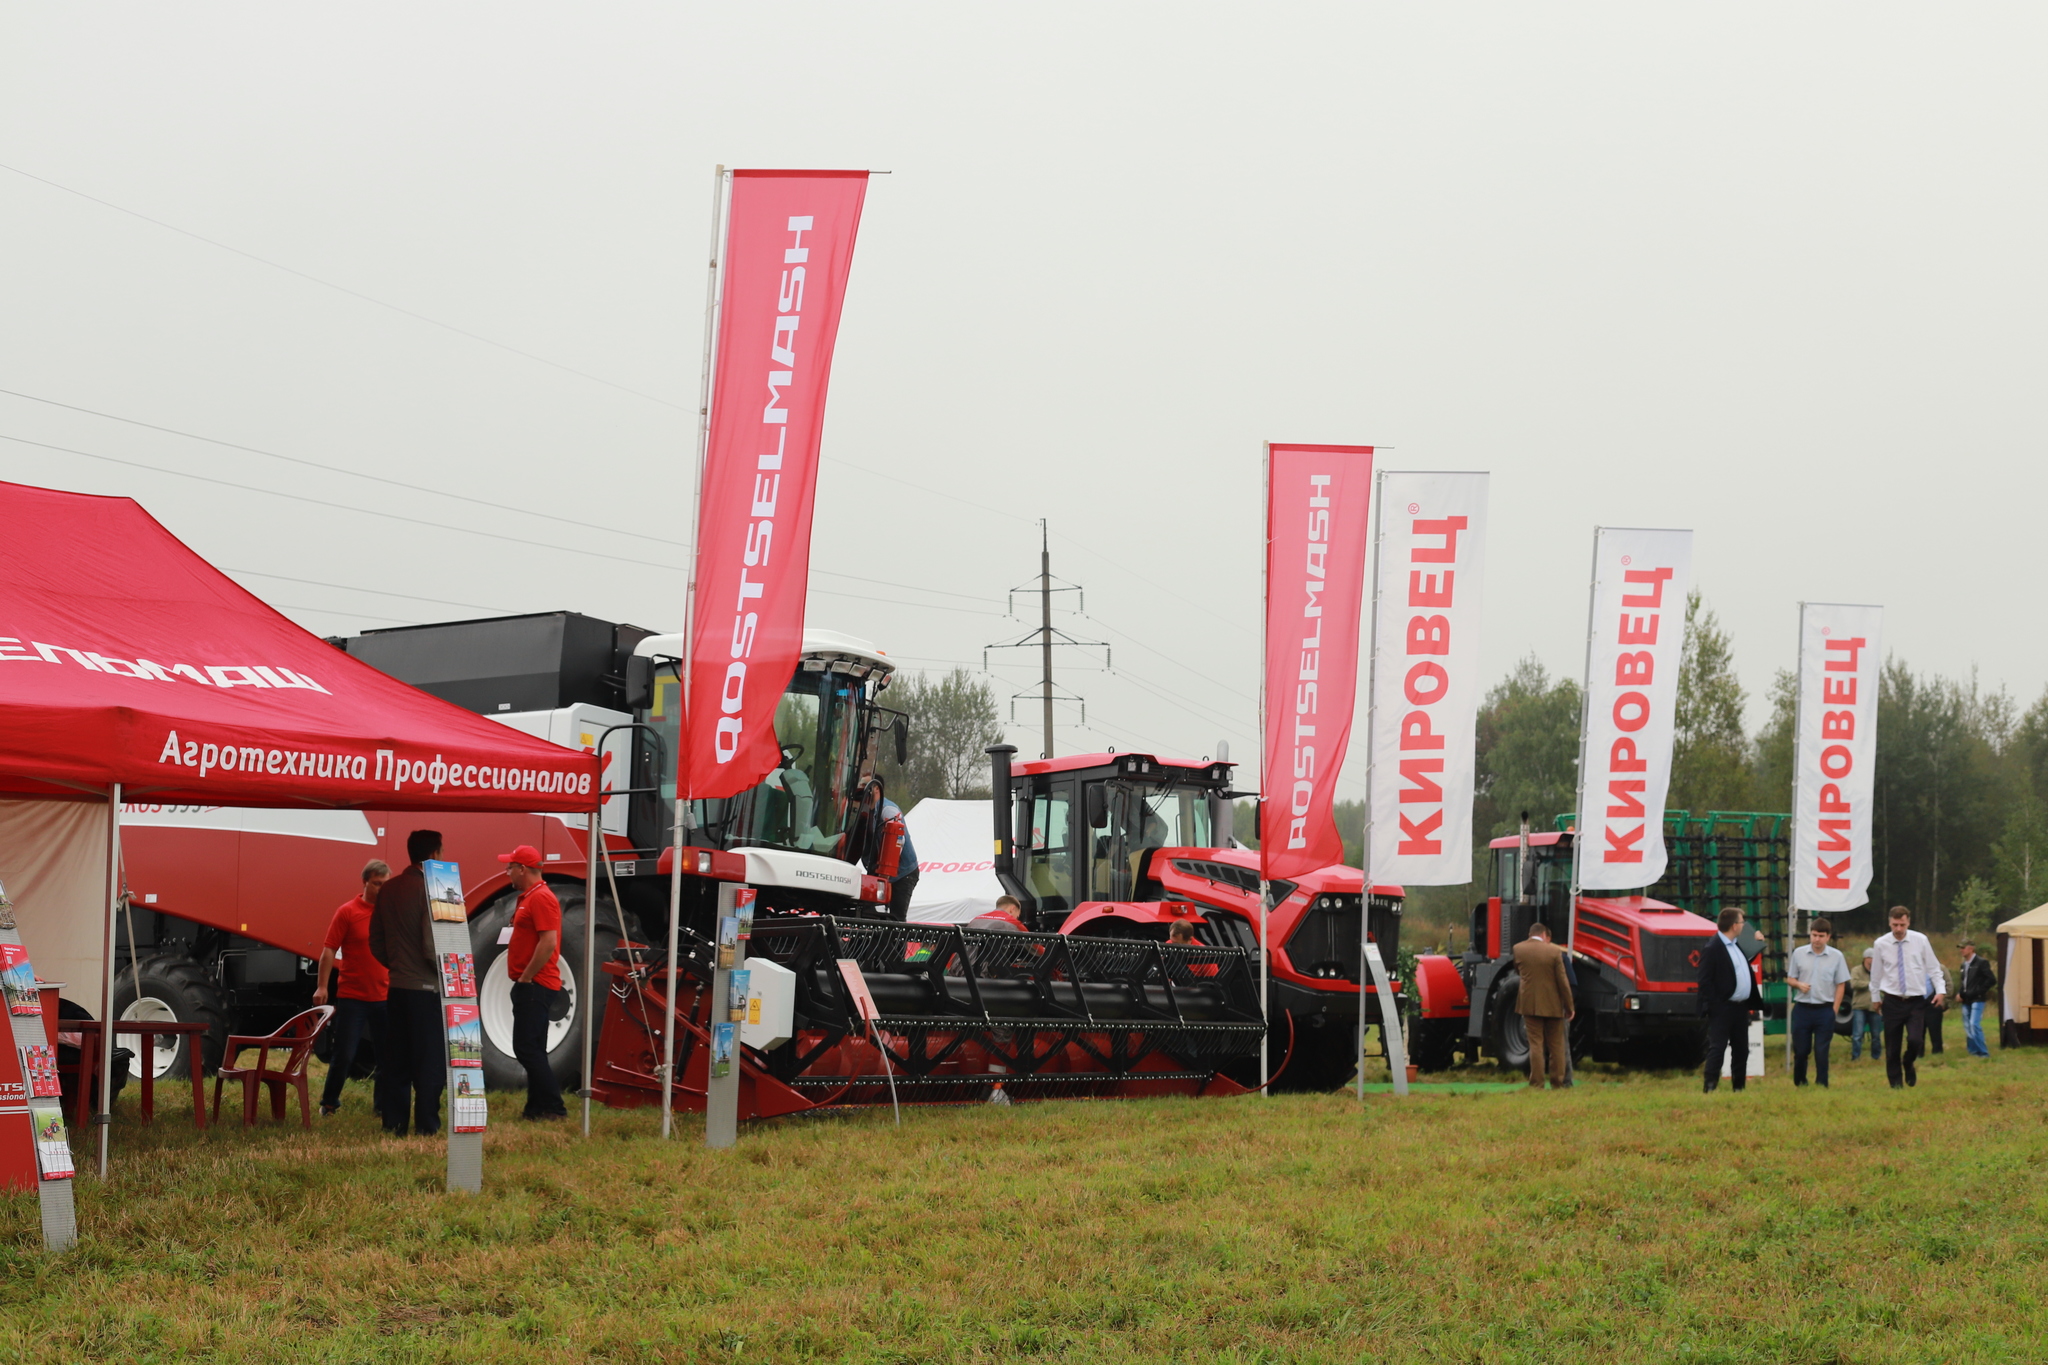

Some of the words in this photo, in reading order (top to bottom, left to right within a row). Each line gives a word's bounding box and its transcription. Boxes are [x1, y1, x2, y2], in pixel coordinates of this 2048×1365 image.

[714, 215, 814, 764] ROSTSELMASH
[158, 731, 366, 781] Агротехника
[374, 749, 591, 795] Профессионалов
[1287, 474, 1331, 850] ROSTSELMASH
[1397, 515, 1468, 856] КИРОВЕЦ
[1603, 567, 1673, 864] КИРОВЕЦ
[1816, 637, 1866, 890] КИРОВЕЦ
